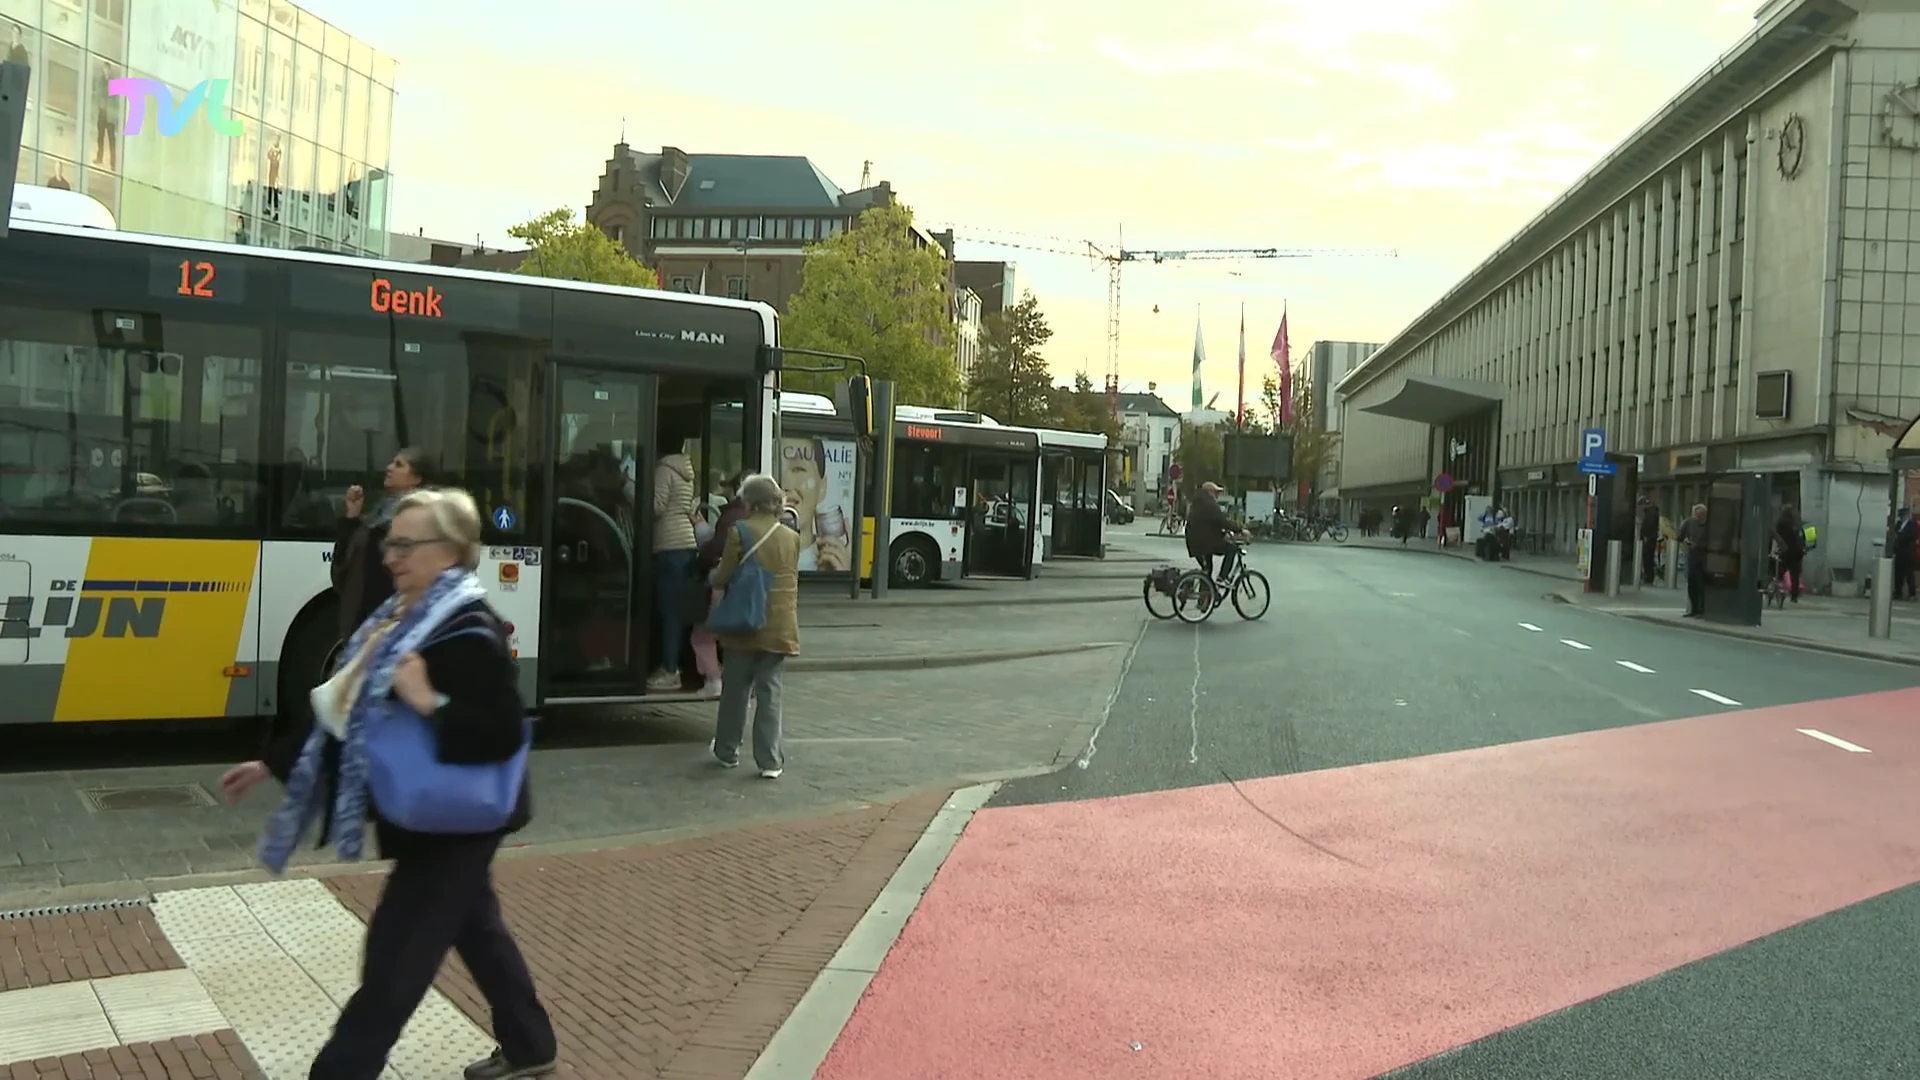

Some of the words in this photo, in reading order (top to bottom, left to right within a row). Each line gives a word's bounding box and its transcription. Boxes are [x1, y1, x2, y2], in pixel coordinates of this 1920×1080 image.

[177, 260, 216, 298] 12
[371, 279, 444, 318] Genk
[681, 330, 725, 344] MAN
[783, 446, 853, 464] CAUALÍE
[1586, 433, 1602, 457] P
[50, 580, 78, 591] DE
[0, 596, 167, 638] LIJN
